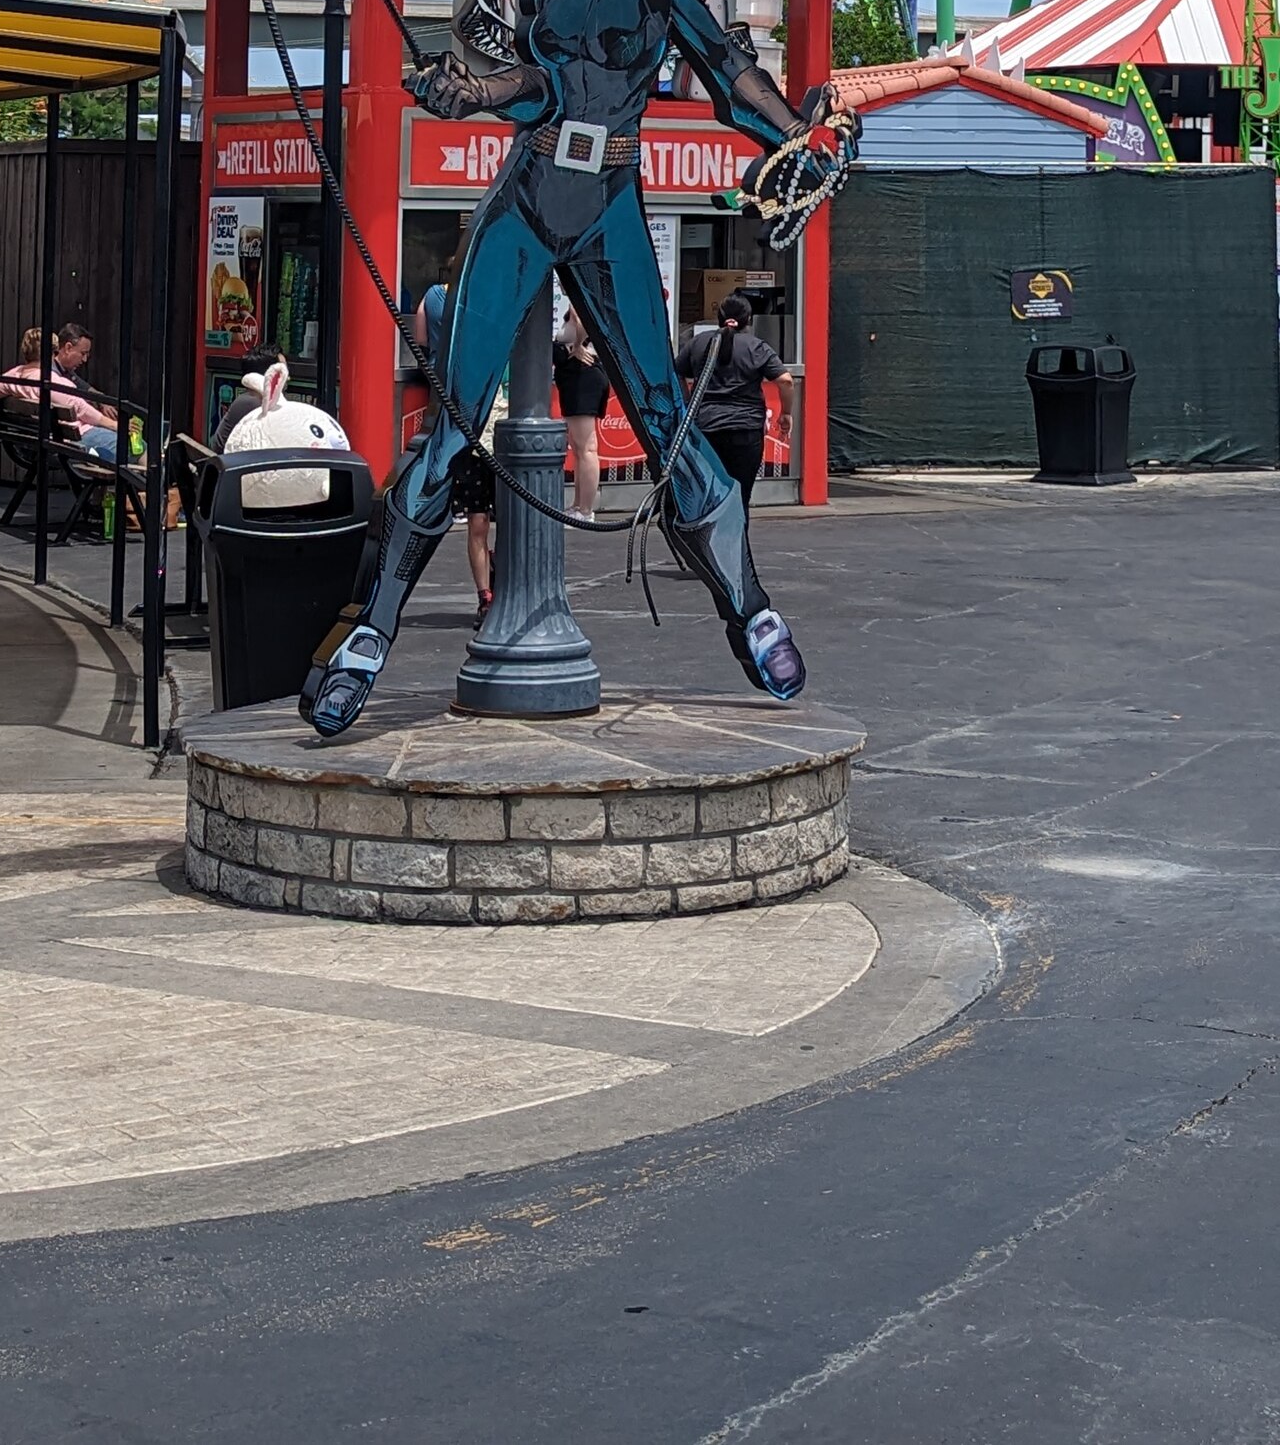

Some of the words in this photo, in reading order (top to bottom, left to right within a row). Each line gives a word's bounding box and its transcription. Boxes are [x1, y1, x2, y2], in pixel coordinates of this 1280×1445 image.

[1218, 66, 1260, 89] THE
[231, 139, 271, 175] REFILL
[273, 138, 320, 175] STATIO
[640, 141, 721, 187] ATION
[217, 226, 235, 238] DEAL
